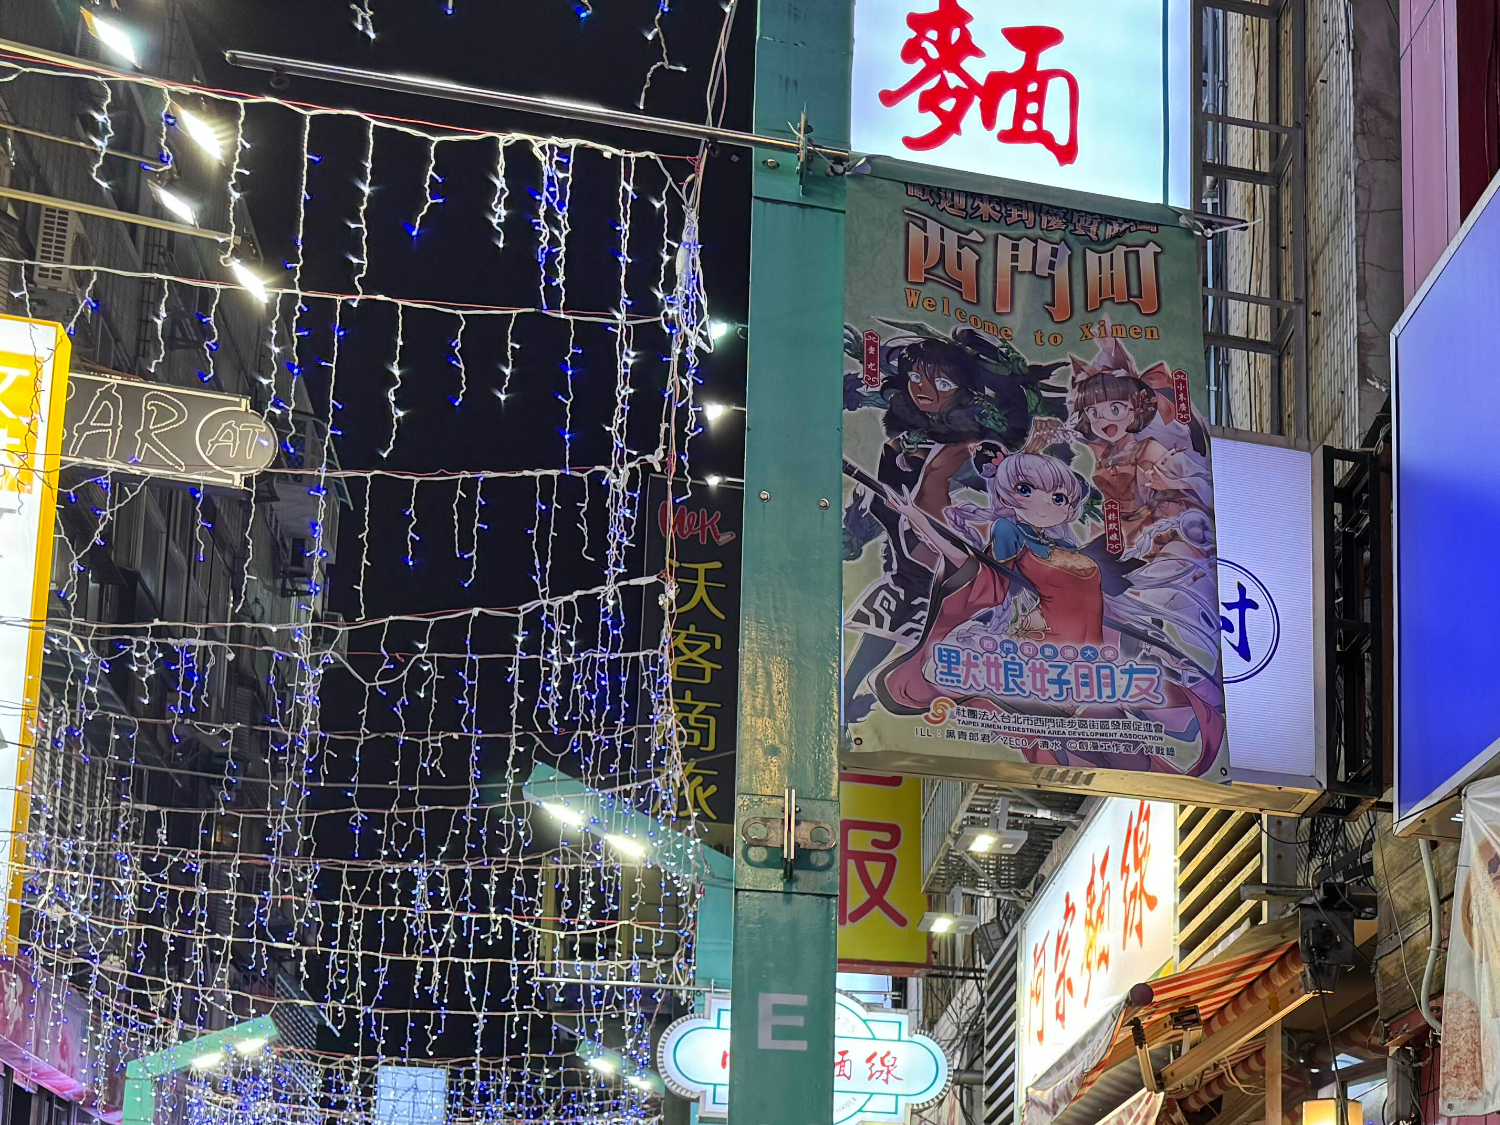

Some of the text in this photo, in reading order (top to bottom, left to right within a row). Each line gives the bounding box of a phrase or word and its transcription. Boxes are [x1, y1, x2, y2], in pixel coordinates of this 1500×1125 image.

[903, 209, 1162, 323] 西門町
[904, 289, 1160, 347] Welcome to Ximen
[62, 381, 187, 471] AR
[206, 423, 261, 459] AT
[937, 646, 1163, 702] 默娘好朋友
[957, 719, 1163, 742] TAIPEI XIMEN PEDESTRIAN AREA DEVELOPMENT ASSOCIATION
[757, 992, 808, 1050] E
